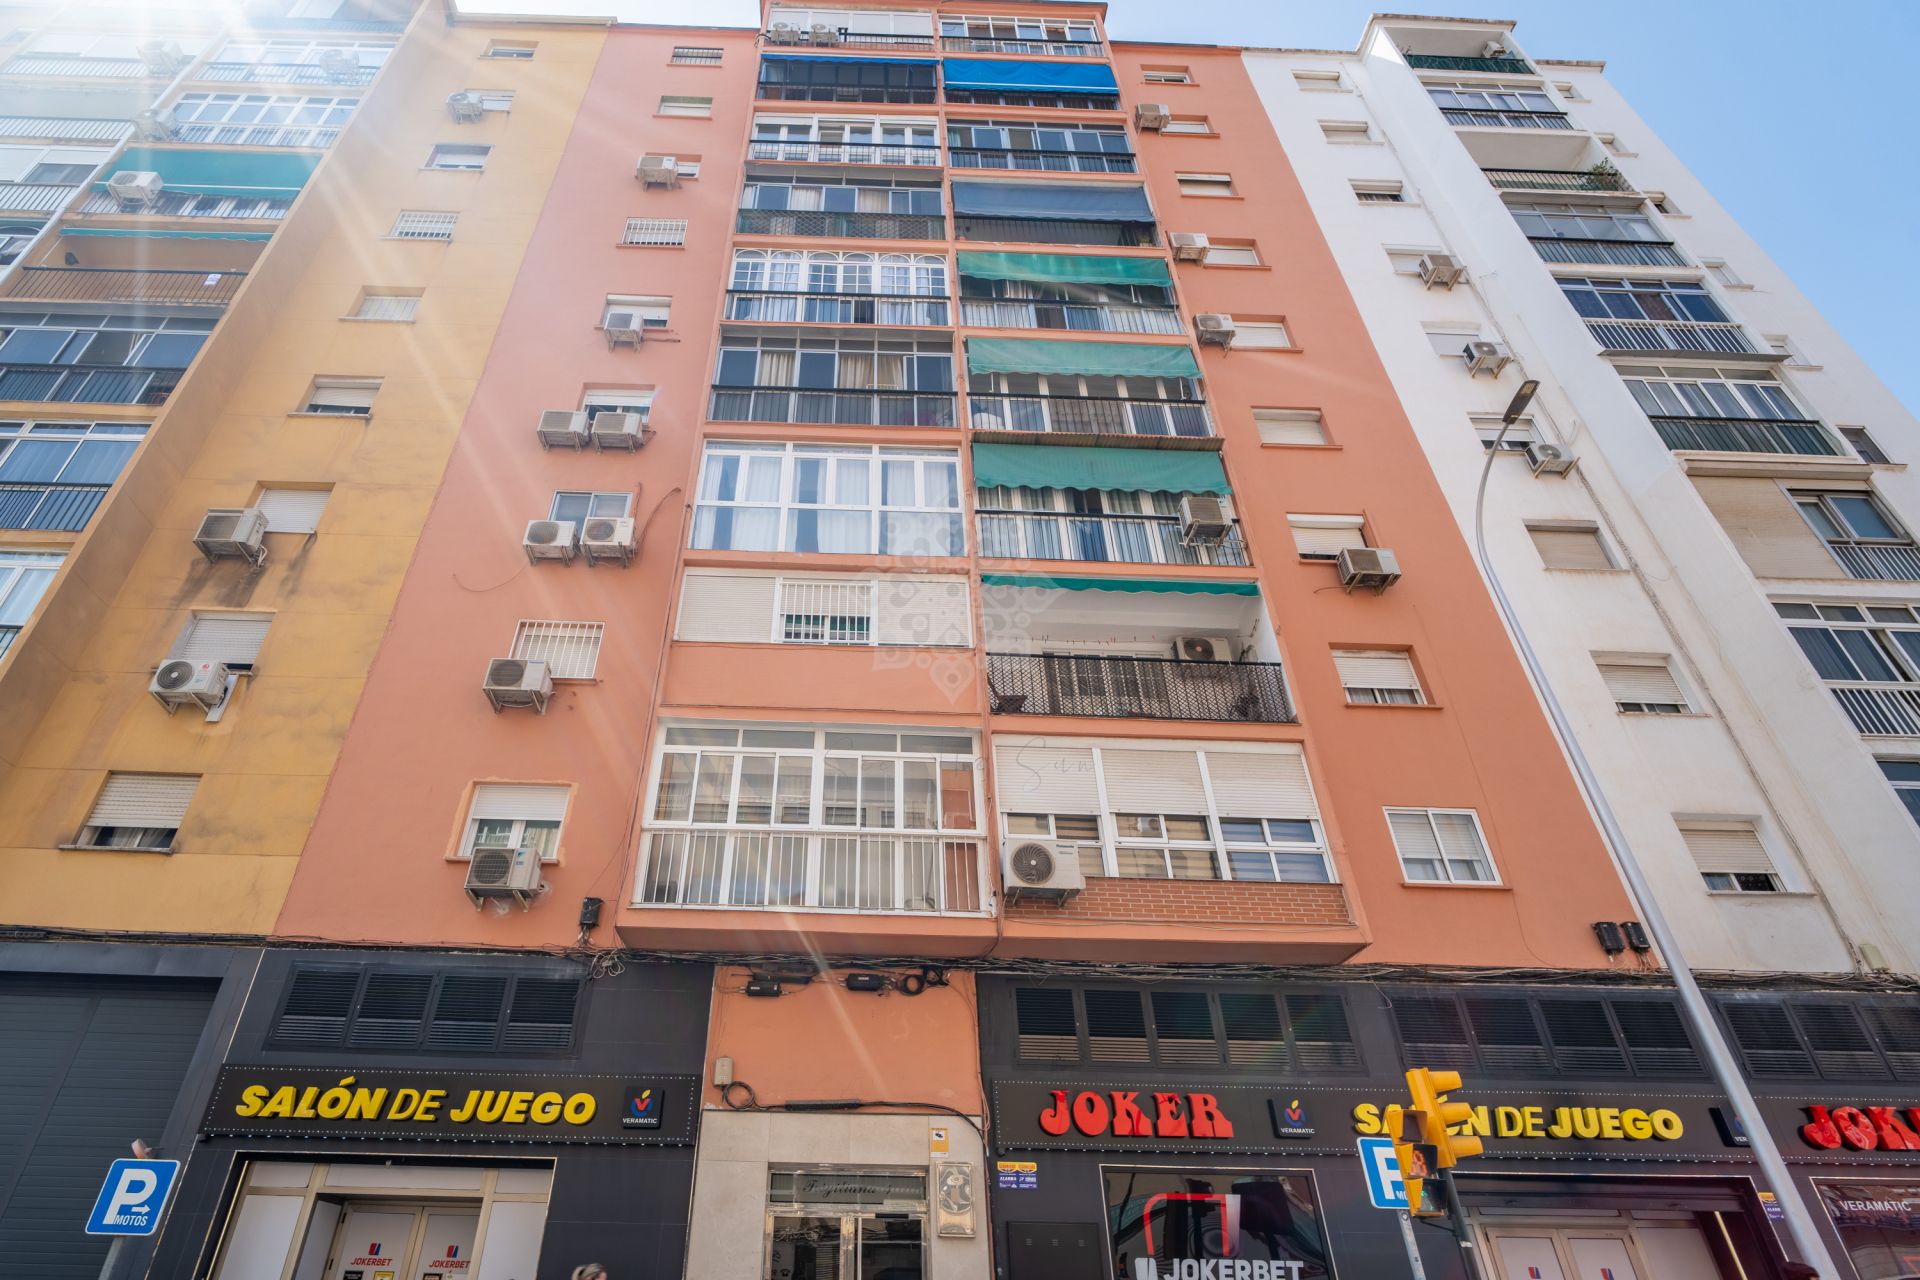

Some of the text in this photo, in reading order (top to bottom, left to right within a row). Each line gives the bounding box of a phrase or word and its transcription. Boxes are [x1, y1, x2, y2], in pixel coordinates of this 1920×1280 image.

[235, 1075, 597, 1124] SALÓN DE JUEGO
[1040, 1090, 1233, 1138] JOKER
[1354, 1094, 1684, 1140] SAN DE JUEGO
[103, 1168, 157, 1224] P
[1839, 1200, 1912, 1212] VERAMATIC
[114, 1214, 148, 1226] MOTOS
[350, 1257, 392, 1266] JOKERBET
[428, 1259, 471, 1269] JOKERBET
[1162, 1258, 1304, 1280] JOKERBET
